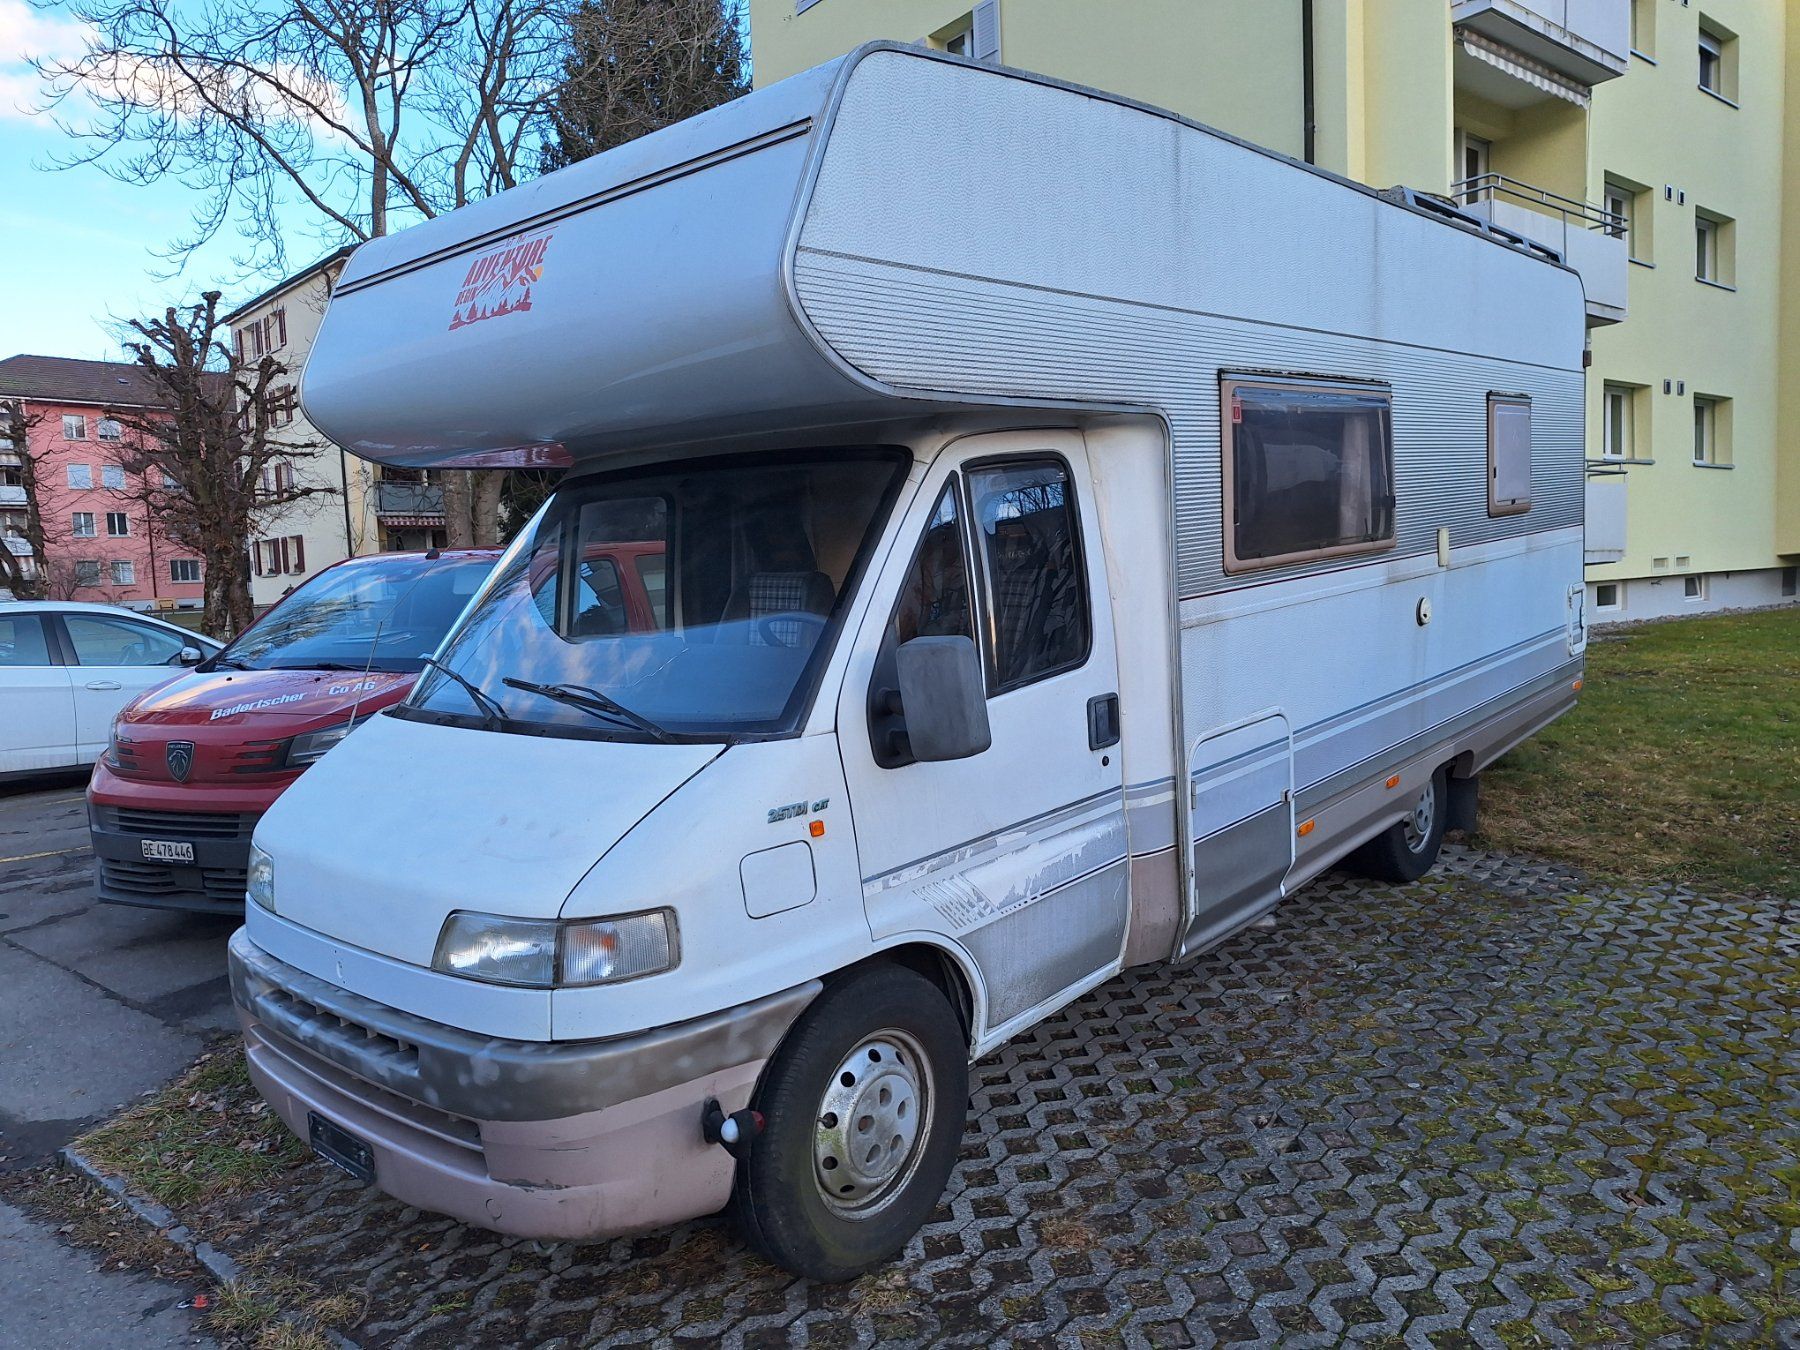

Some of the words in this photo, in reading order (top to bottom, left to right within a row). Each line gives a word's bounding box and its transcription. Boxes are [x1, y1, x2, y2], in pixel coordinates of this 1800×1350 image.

[209, 692, 307, 721] Badertscher
[329, 685, 349, 695] Co
[352, 681, 376, 692] AG
